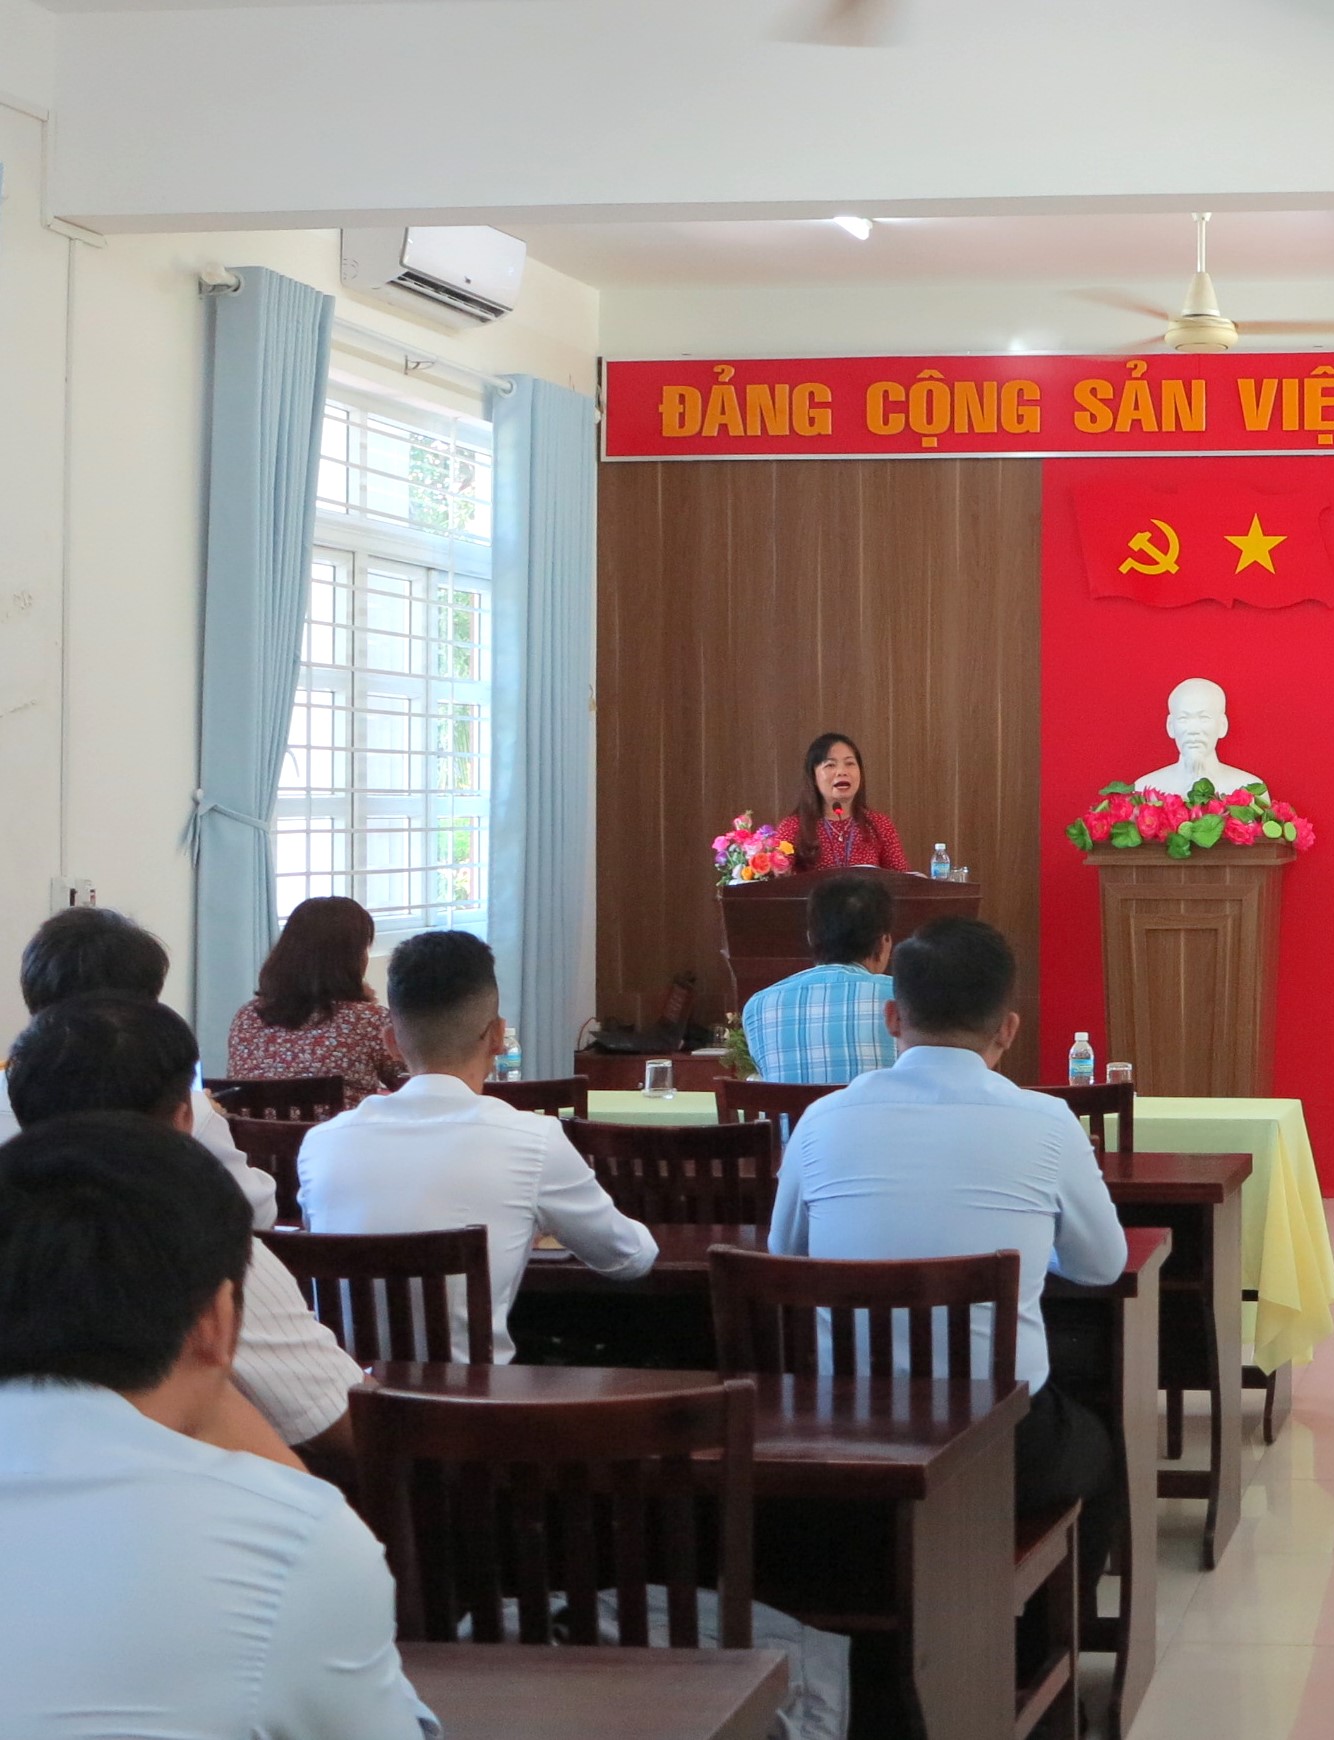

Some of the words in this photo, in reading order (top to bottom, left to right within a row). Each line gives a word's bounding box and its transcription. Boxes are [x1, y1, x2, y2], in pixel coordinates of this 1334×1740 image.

[660, 365, 832, 437] ĐẢNG
[866, 369, 1041, 447] CỘNG
[1075, 360, 1207, 434] SẢN
